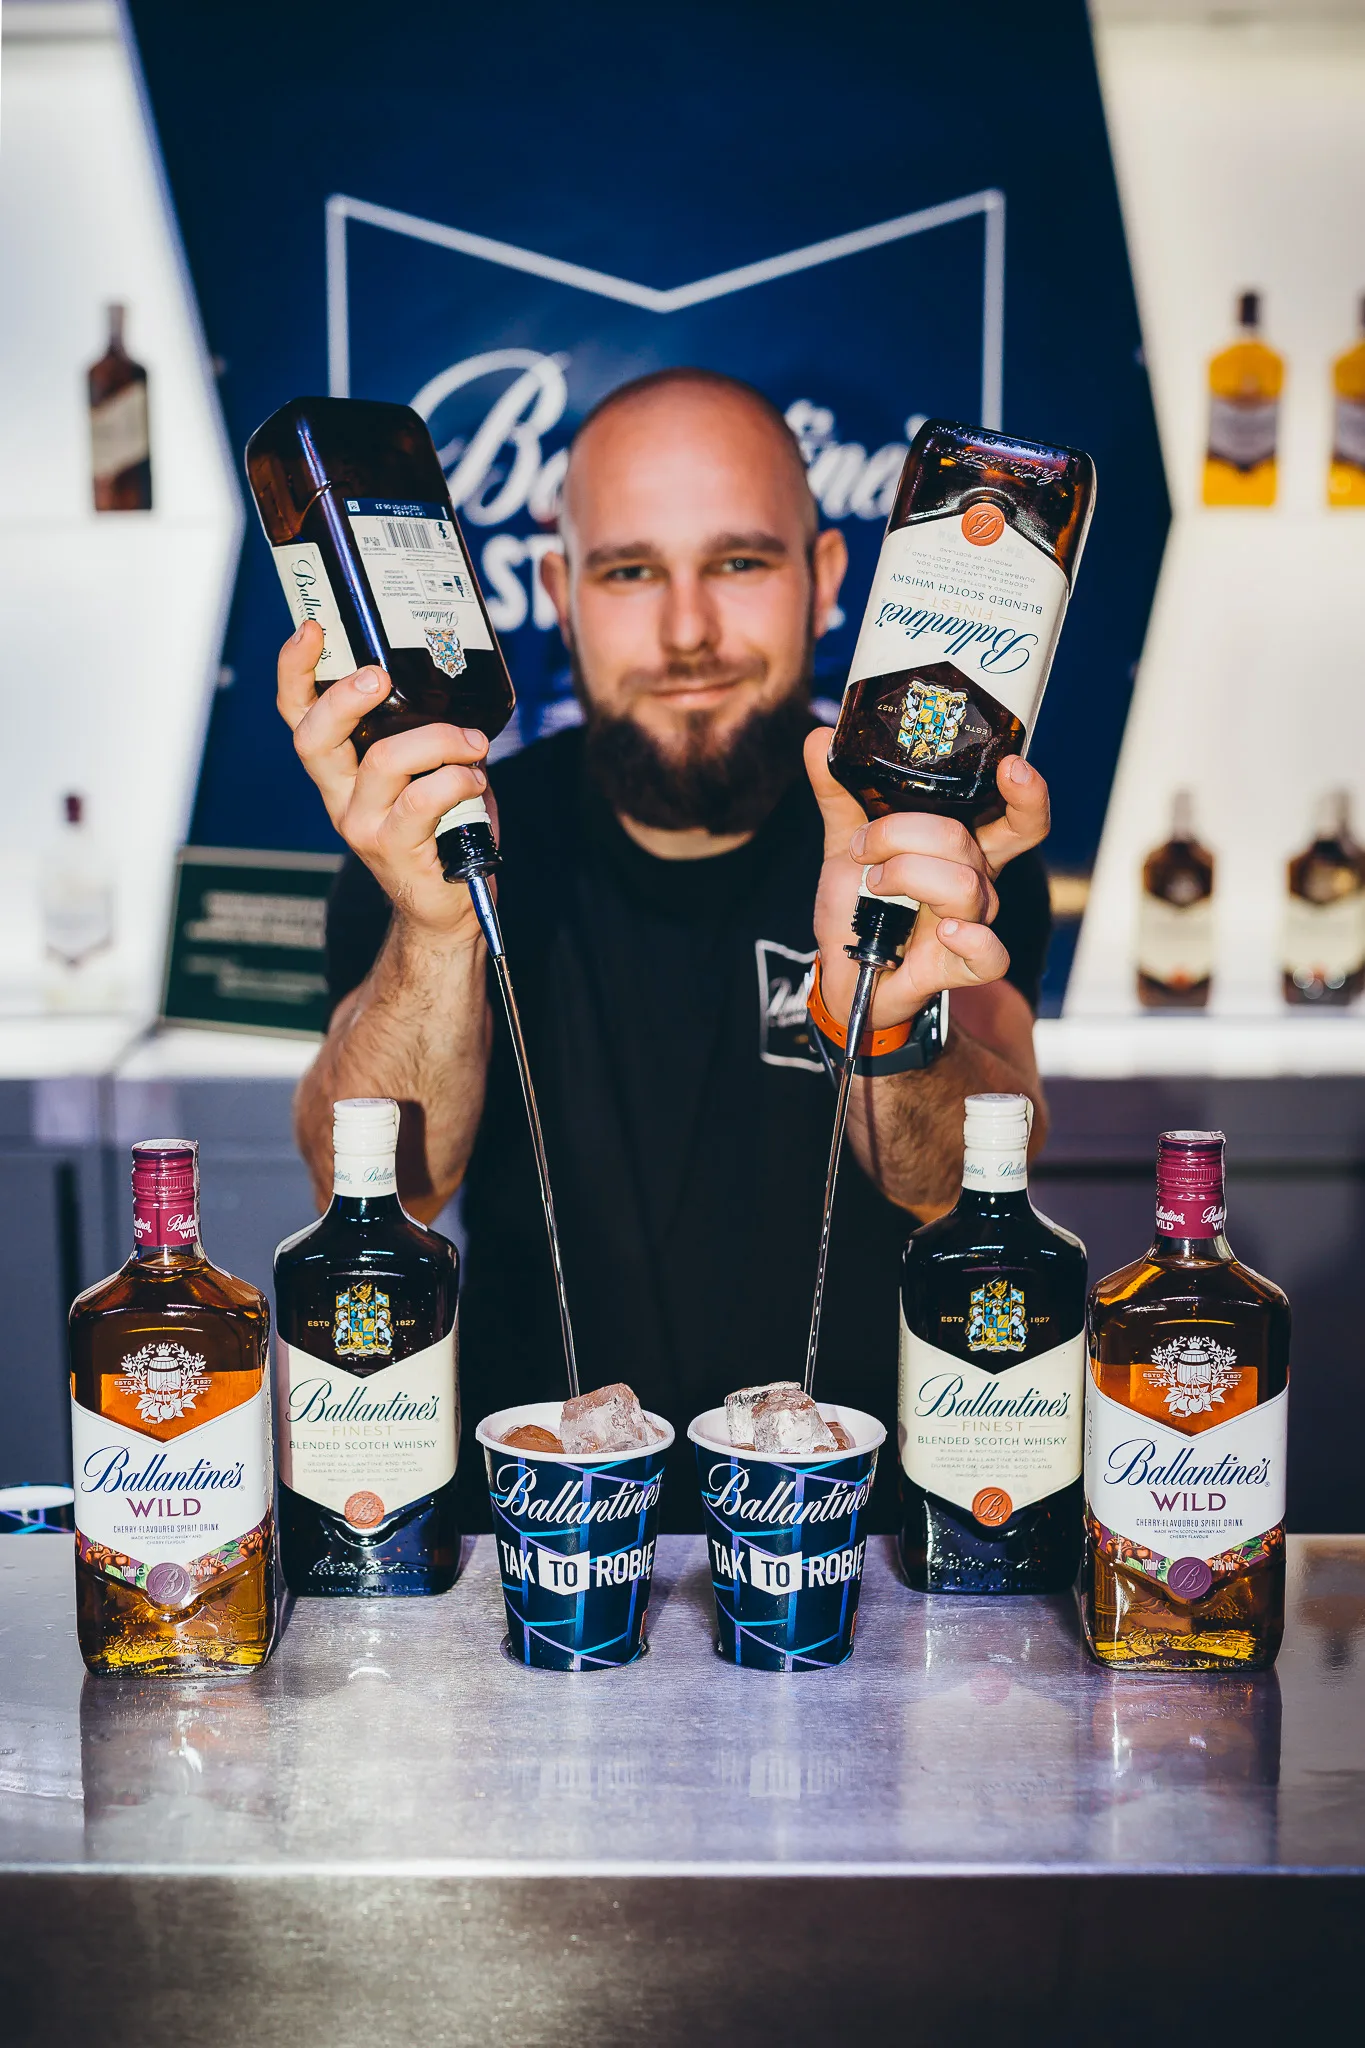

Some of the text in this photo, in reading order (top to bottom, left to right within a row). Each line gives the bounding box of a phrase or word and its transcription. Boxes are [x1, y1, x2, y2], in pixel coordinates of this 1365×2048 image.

[933, 562, 949, 572] AND
[950, 566, 998, 583] BALLANTINE
[890, 572, 1043, 615] BLENDED SCOTCH WHISKY
[999, 576, 1029, 590] GEORGE
[929, 597, 994, 621] FINEST
[875, 602, 1039, 674] Ballantine's
[877, 703, 988, 735] ESTD 1827
[285, 1378, 440, 1423] Ballantine's
[914, 1372, 1071, 1418] Ballantine's
[332, 1425, 394, 1437] FINEST
[962, 1421, 1025, 1432] FINEST
[289, 1440, 438, 1450] BLENDED SCOTCH WHISKY
[917, 1435, 1068, 1446] BLENDED SCOTCH WHISKY
[80, 1445, 245, 1493] Ballantine's
[1103, 1438, 1271, 1486] Ballantine's
[496, 1463, 663, 1524] Ballantine's
[1150, 1490, 1227, 1512] WILD
[126, 1497, 201, 1518] WILD
[113, 1523, 220, 1533] CHERRY-FLAVOURED SPIRIT DRINK
[1136, 1518, 1243, 1527] CHERRY-FLAVOURED SPIRIT DRINK
[500, 1540, 535, 1584] TAK
[548, 1560, 578, 1588] TO
[712, 1539, 747, 1584] TAK
[761, 1560, 790, 1588] TO
[1212, 1559, 1225, 1571] 30%
